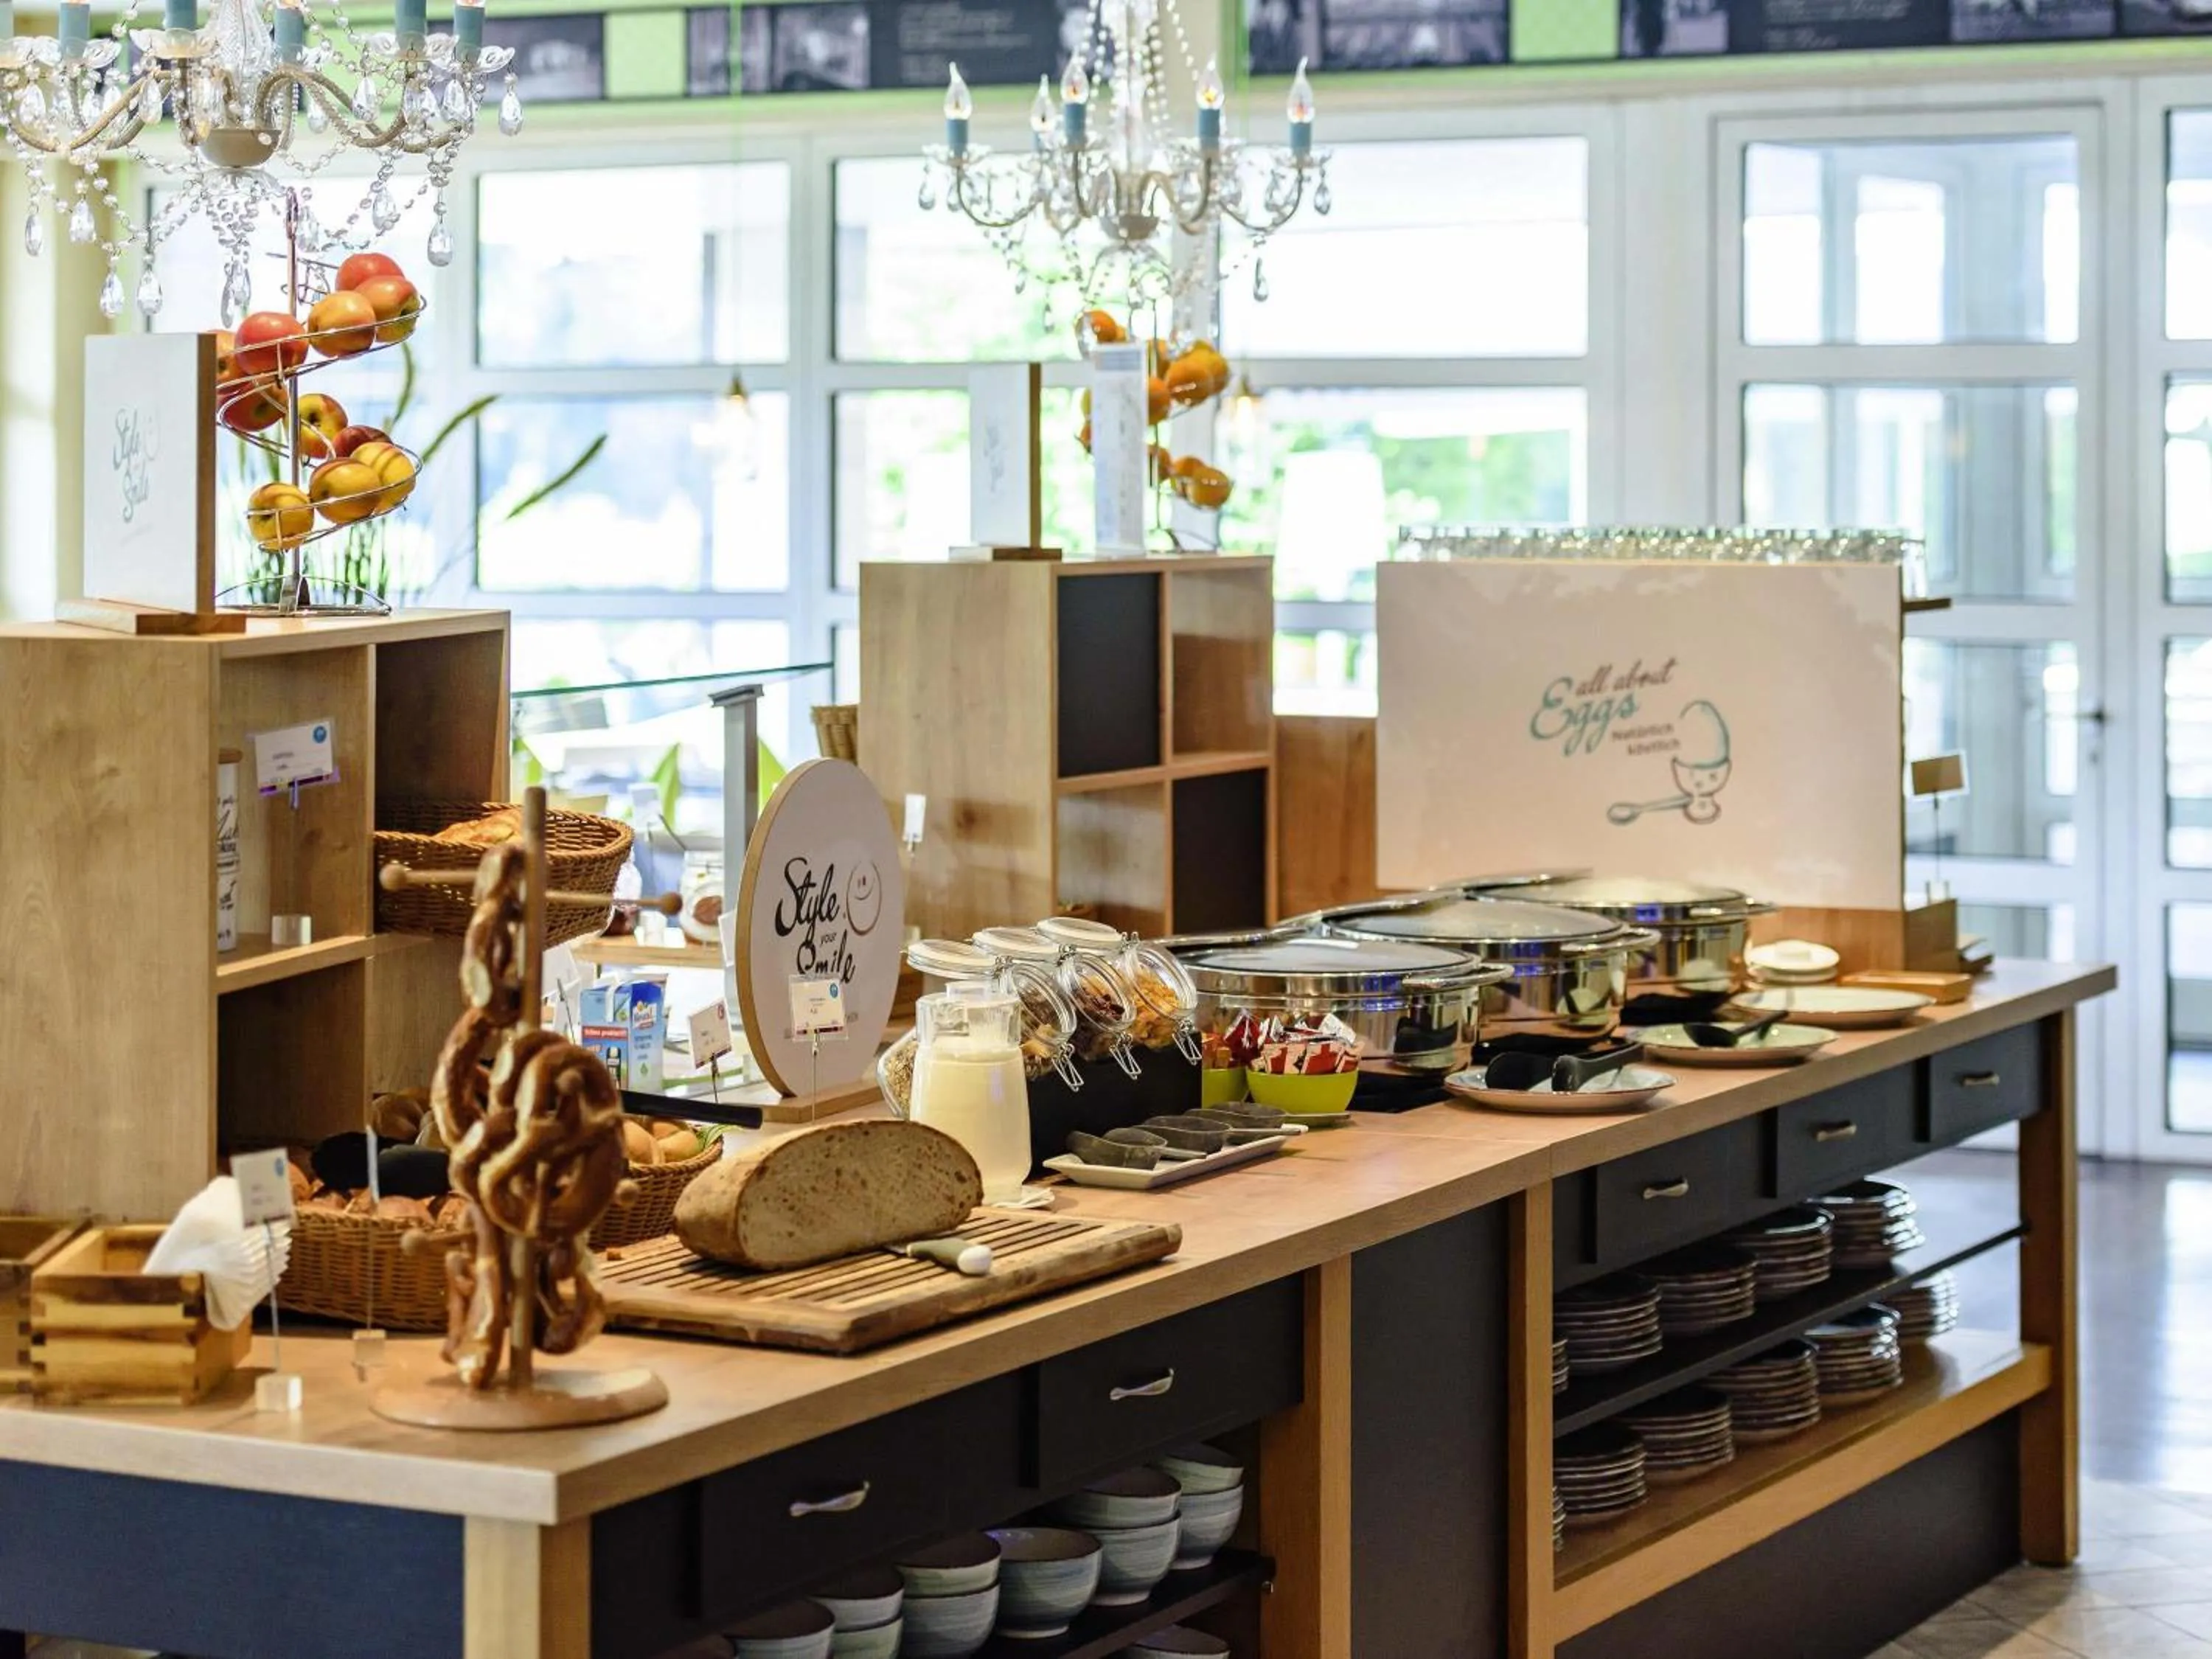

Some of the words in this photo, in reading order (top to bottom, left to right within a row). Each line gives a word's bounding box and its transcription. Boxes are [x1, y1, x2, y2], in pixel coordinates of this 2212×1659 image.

[1575, 663, 1613, 697] all
[1613, 657, 1675, 691] about
[1531, 676, 1641, 757] Eggs
[775, 857, 840, 942] Style
[818, 932, 837, 947] your
